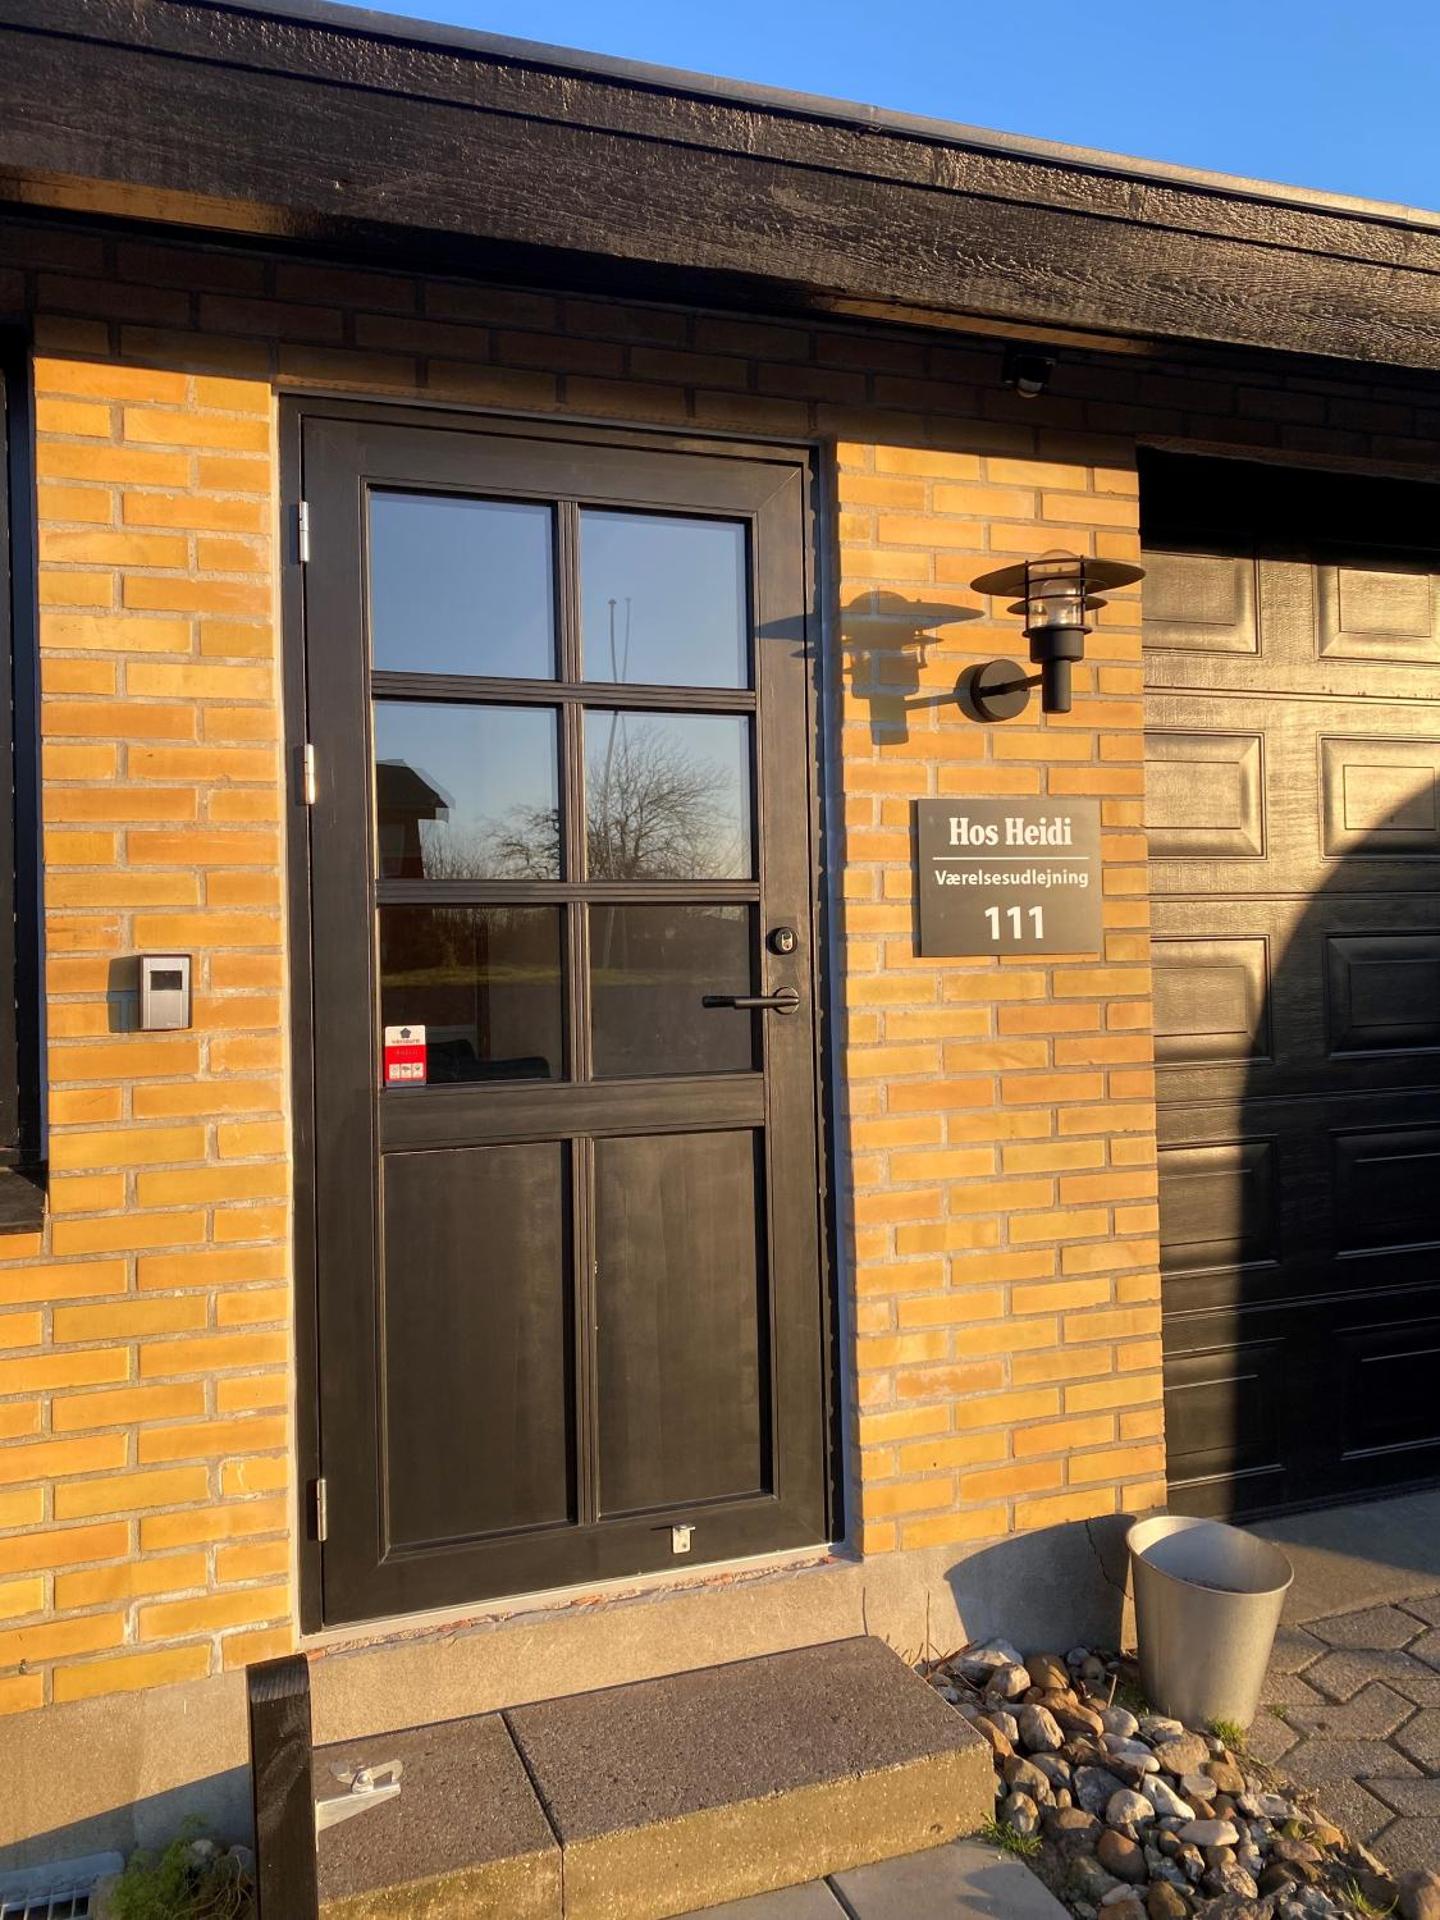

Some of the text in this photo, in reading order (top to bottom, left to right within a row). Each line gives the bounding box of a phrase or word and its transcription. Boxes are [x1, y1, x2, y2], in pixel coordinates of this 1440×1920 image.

[949, 817, 1073, 846] Hos Heidi
[935, 868, 1090, 888] Værelsesudlejning
[984, 906, 1044, 941] 111
